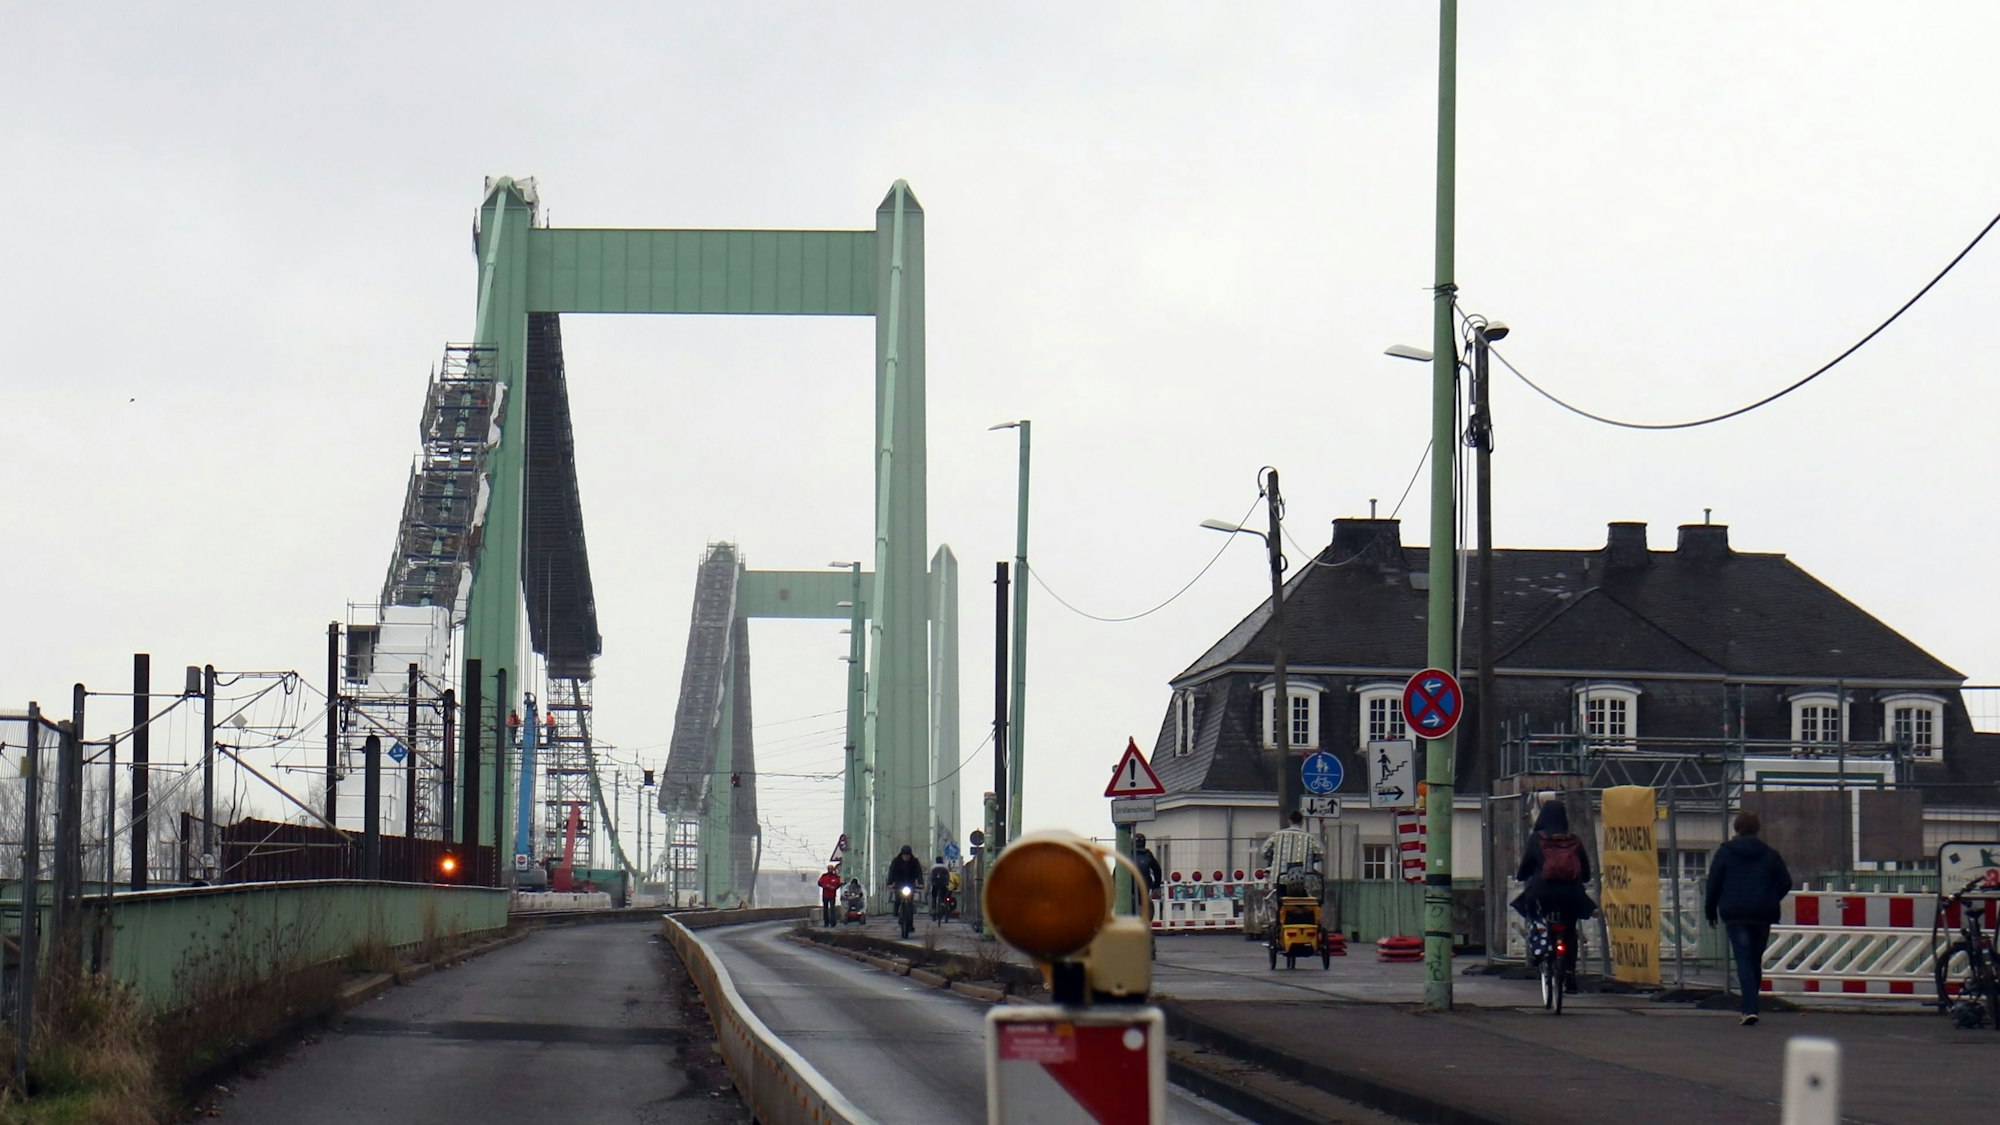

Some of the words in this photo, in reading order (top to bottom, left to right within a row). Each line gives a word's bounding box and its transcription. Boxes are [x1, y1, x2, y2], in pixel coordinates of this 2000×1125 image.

[1619, 826, 1652, 852] BAUEN
[1605, 903, 1653, 929] STRUKTUR
[1623, 936, 1649, 968] KÖLN
